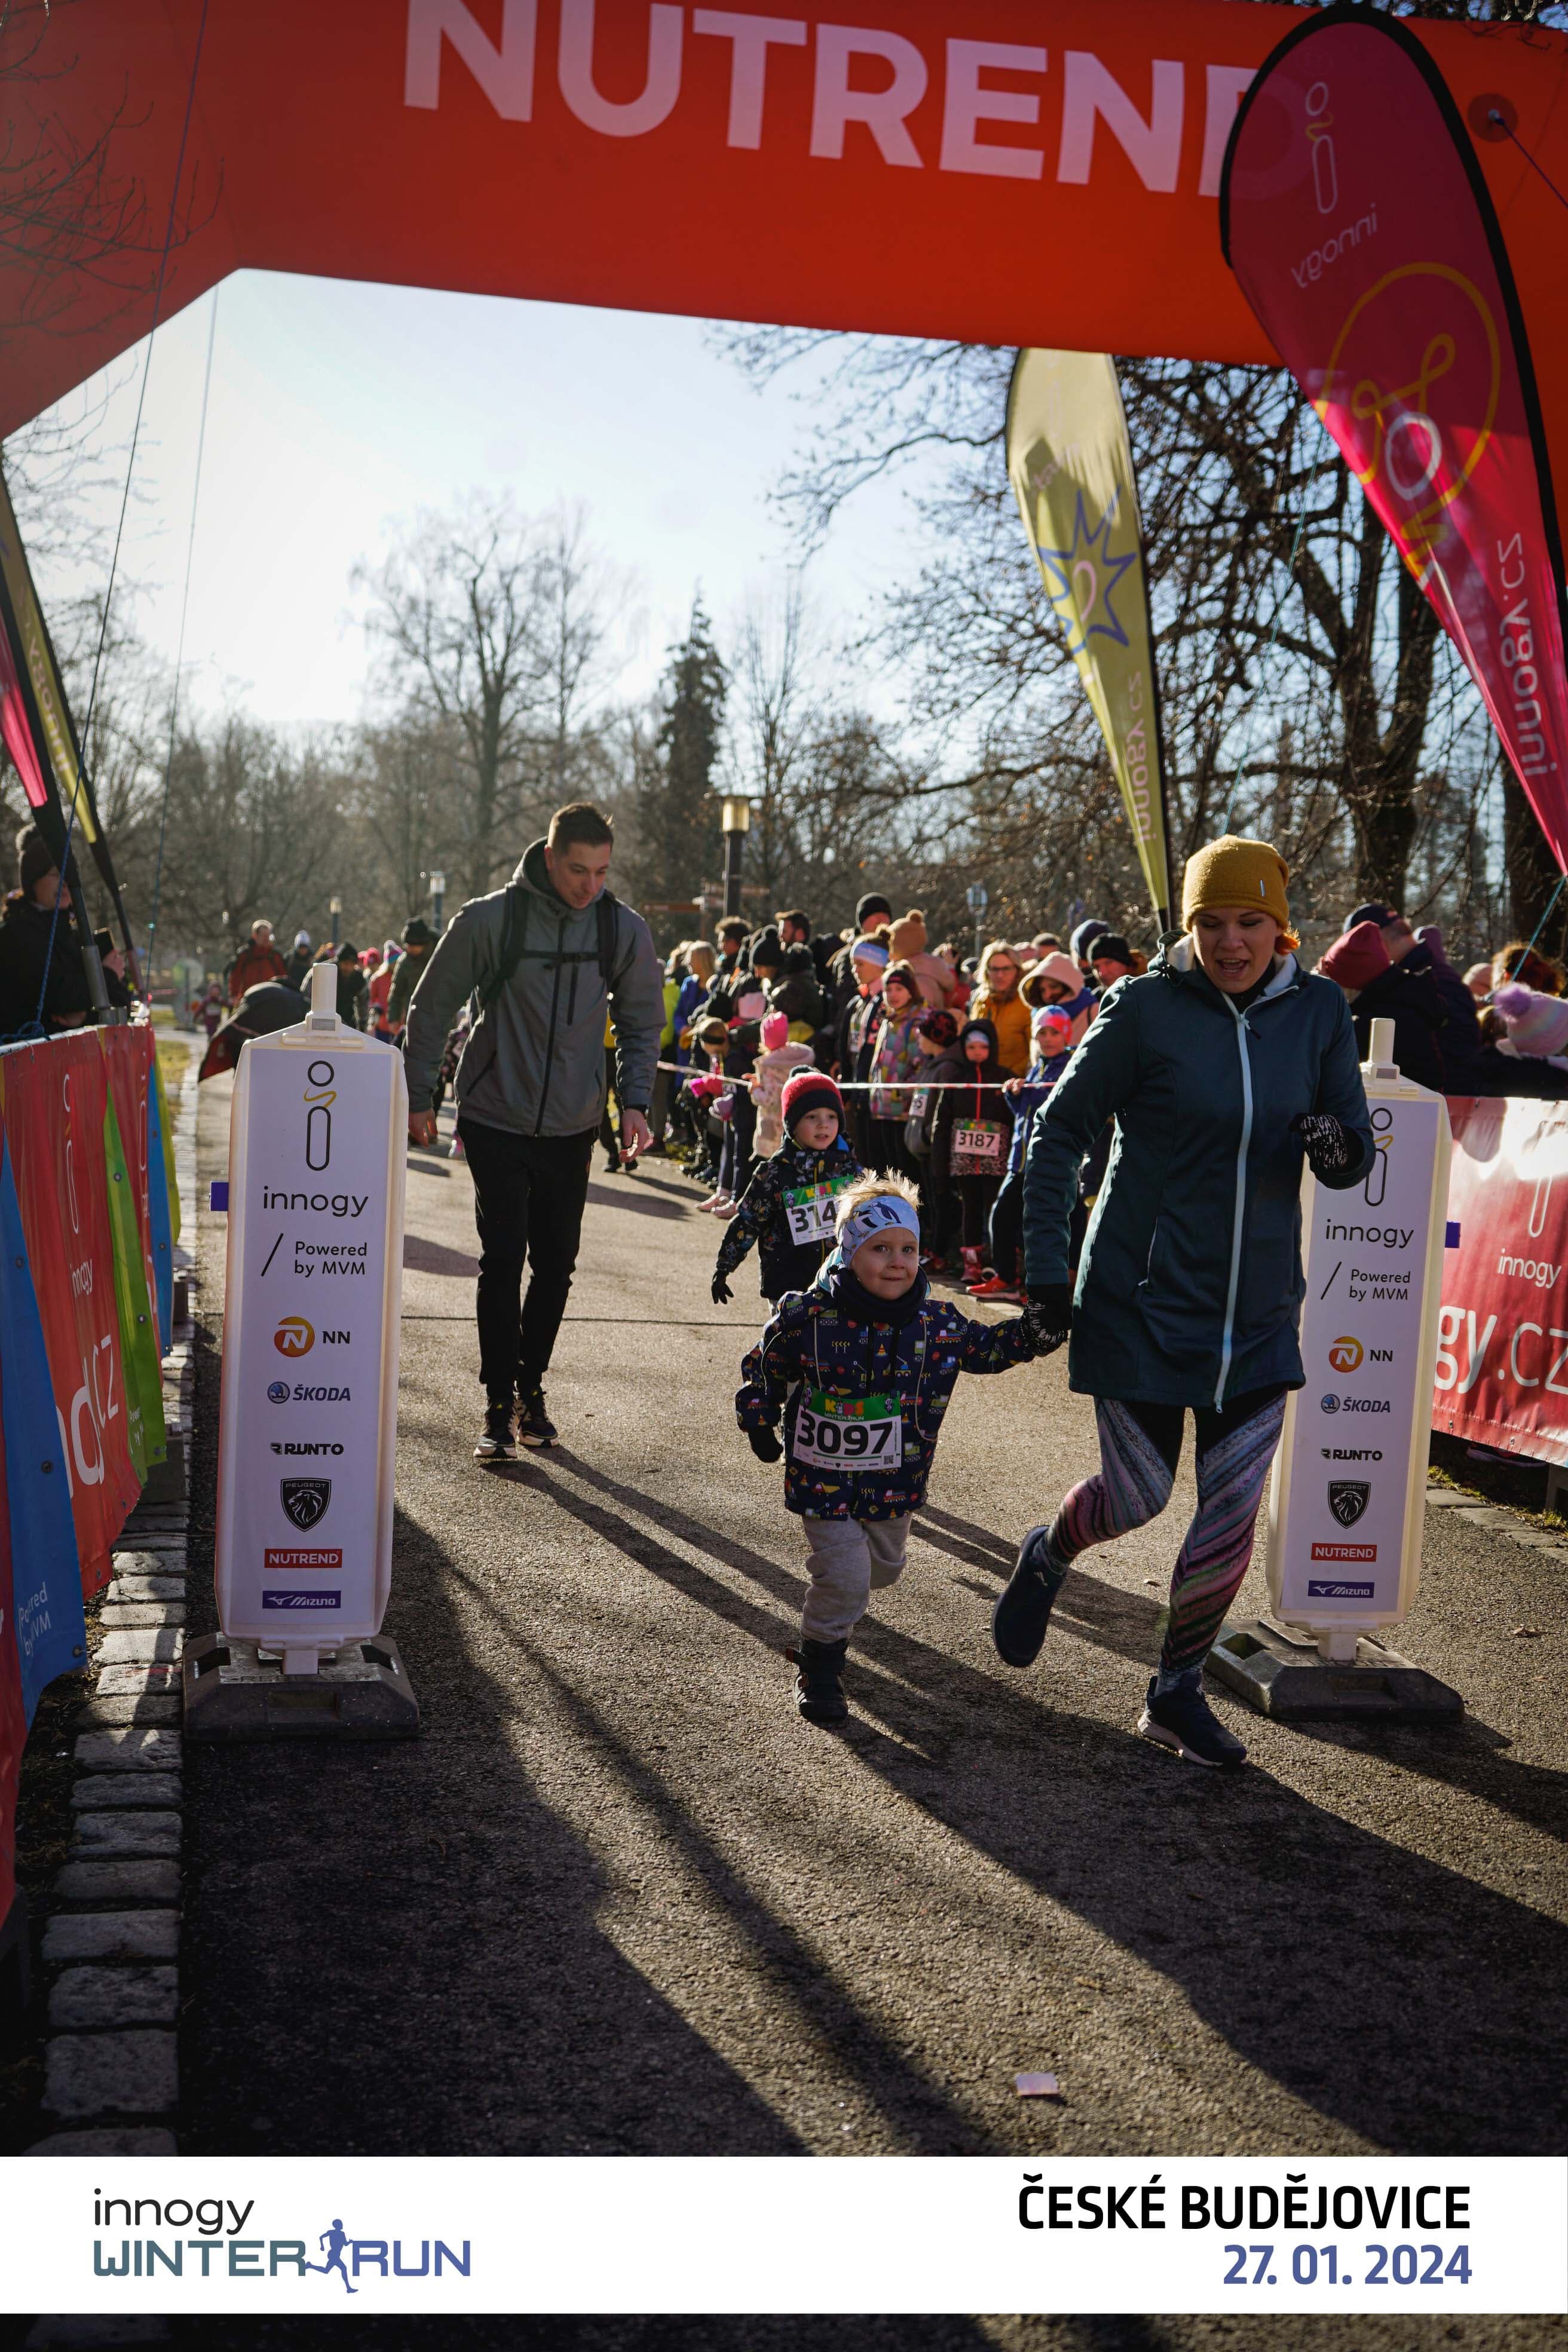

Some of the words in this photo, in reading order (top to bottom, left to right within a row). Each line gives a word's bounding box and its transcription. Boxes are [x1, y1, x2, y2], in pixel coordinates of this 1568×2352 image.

[958, 1132, 995, 1147] 3187
[264, 1186, 368, 1217] innogy
[791, 1200, 837, 1233] 314
[1325, 1219, 1414, 1248] innogy
[296, 1241, 368, 1256] Powered
[295, 1260, 314, 1278] by
[322, 1261, 366, 1275] MVM
[1351, 1269, 1410, 1284] Powered
[1497, 1249, 1561, 1288] innogy
[1349, 1285, 1366, 1301] by
[1373, 1288, 1408, 1300] MVM
[322, 1331, 351, 1344] NN
[1370, 1349, 1393, 1362] NN
[1435, 1306, 1568, 1395] gy.cz
[292, 1384, 351, 1402] ŠKODA
[1342, 1397, 1391, 1413] ŠKODA
[797, 1411, 893, 1456] 3097
[284, 1443, 344, 1456] RUNTO
[1333, 1449, 1383, 1461] RUNTO
[269, 1553, 339, 1564] NUTREND
[1315, 1547, 1374, 1558] NUTREND
